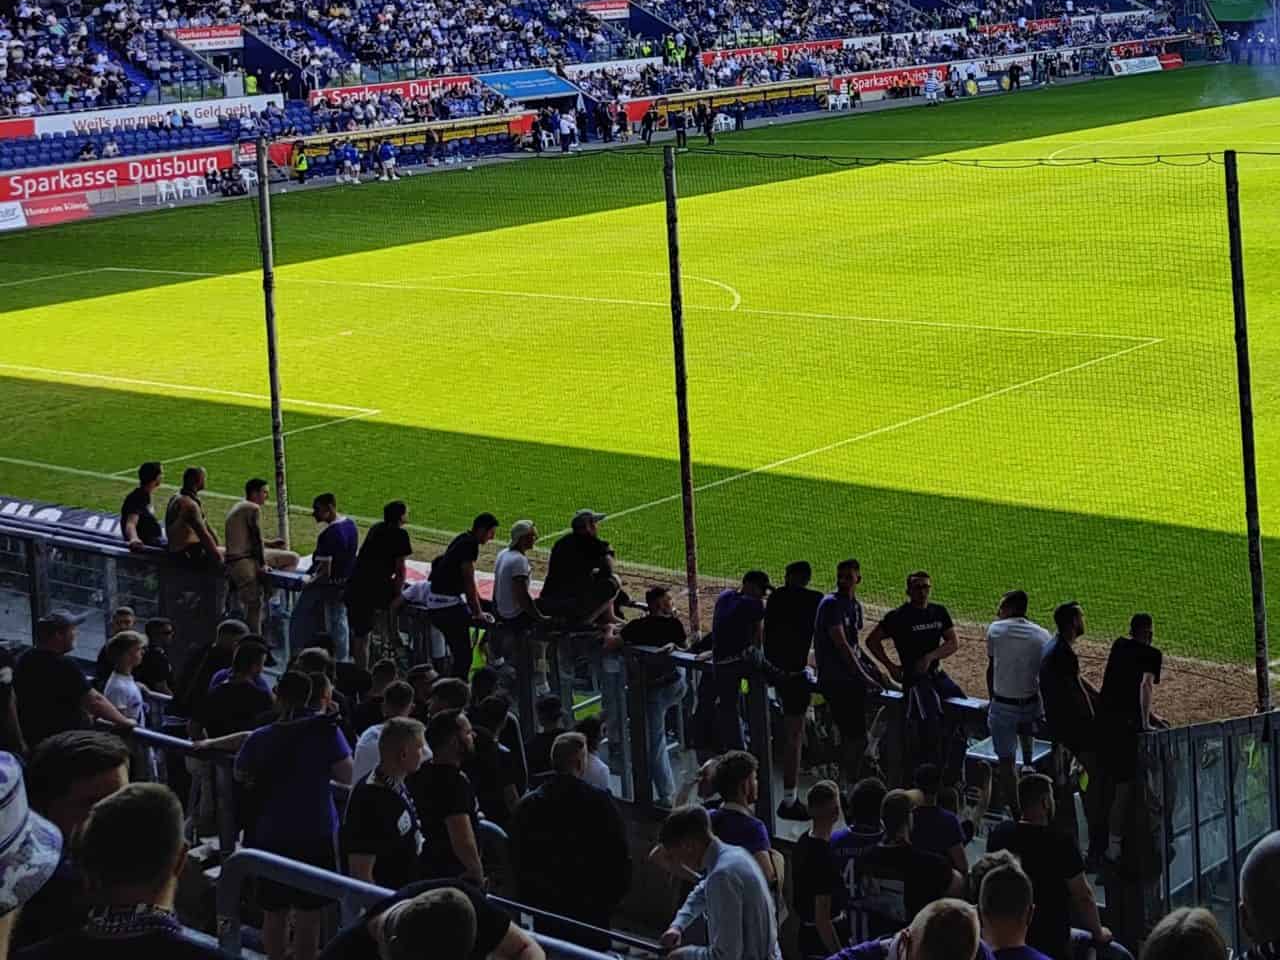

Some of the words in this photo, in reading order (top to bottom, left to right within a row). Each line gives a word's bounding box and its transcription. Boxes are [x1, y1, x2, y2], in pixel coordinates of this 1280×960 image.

[194, 106, 221, 119] Geld
[9, 168, 118, 199] Sparkasse
[129, 155, 219, 182] Duisburg
